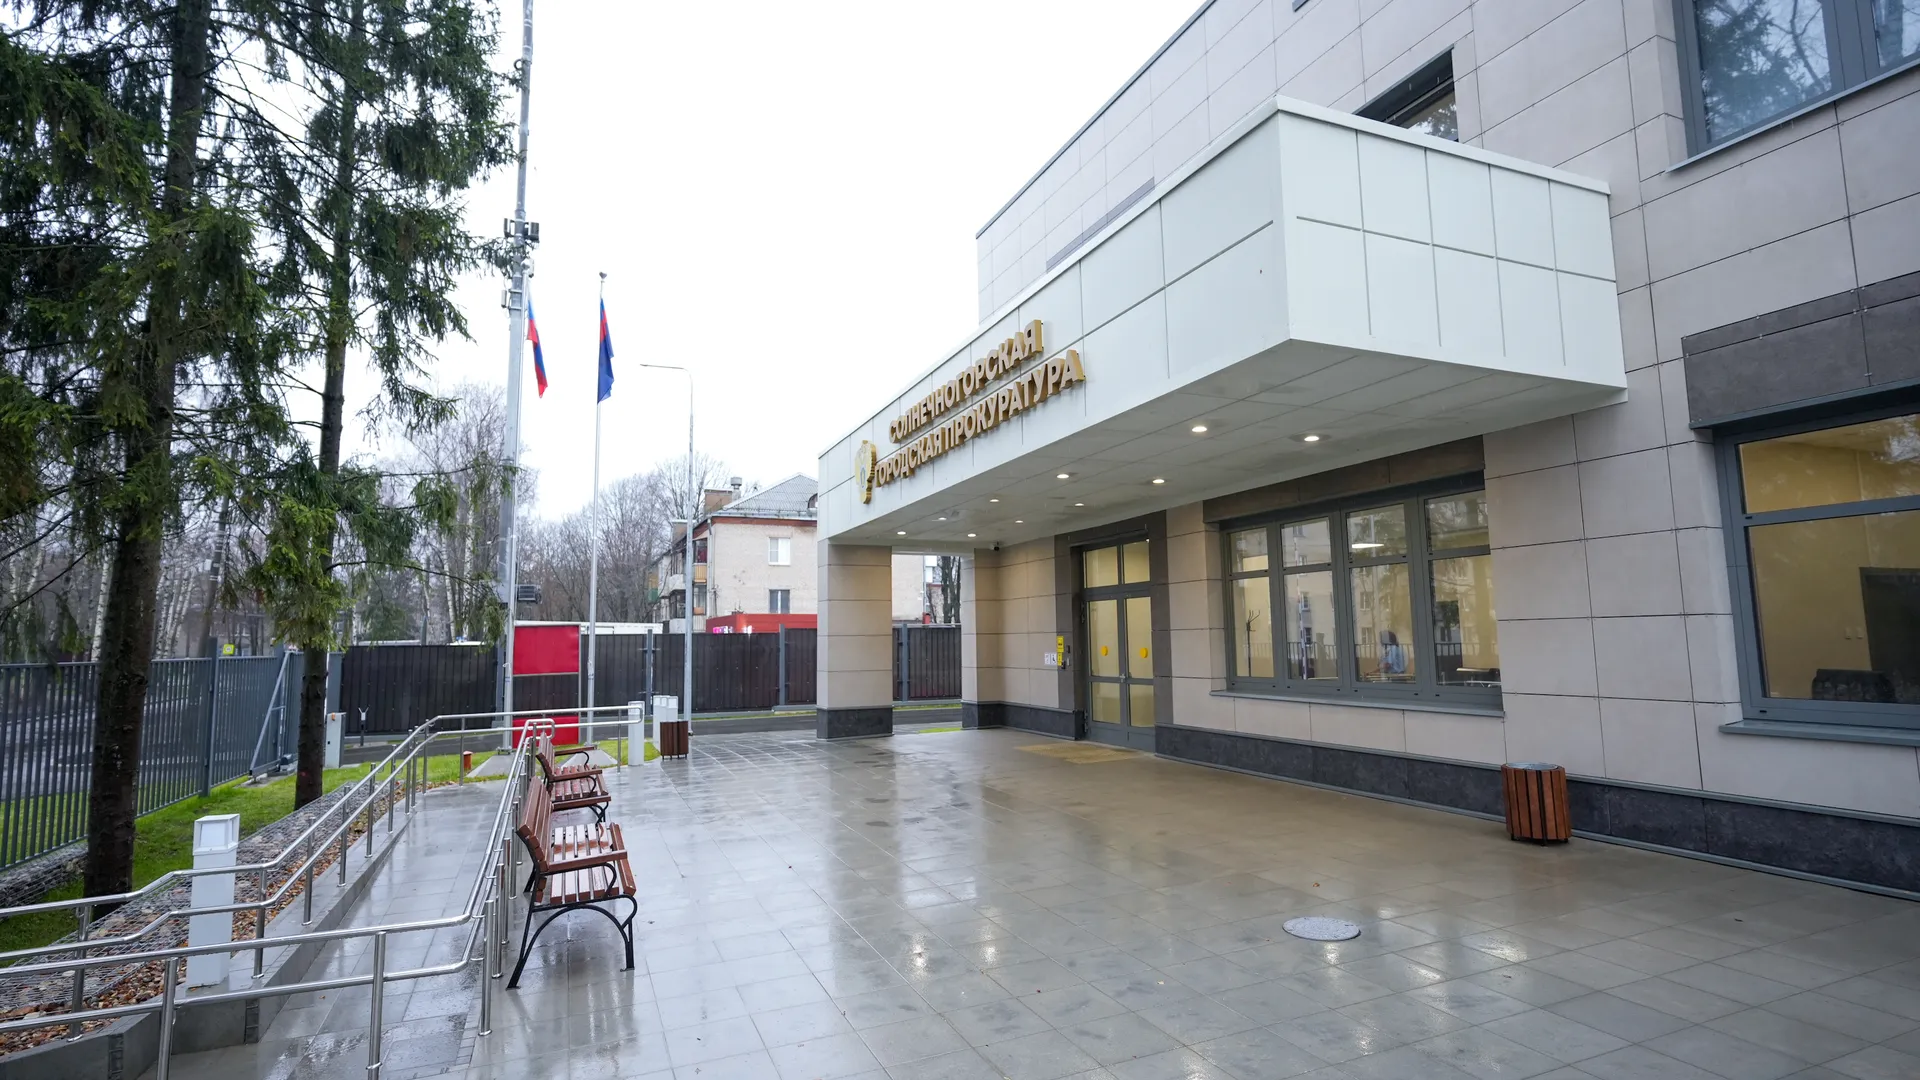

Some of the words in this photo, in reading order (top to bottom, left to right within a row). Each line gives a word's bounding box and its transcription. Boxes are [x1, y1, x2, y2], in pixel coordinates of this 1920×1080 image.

[874, 427, 946, 487] ГОРОДСКАЯ
[944, 349, 1085, 450] ПРОКУРАТУРА
[888, 319, 1043, 443] СОЛНЕЧНОГОРСКАЯ
